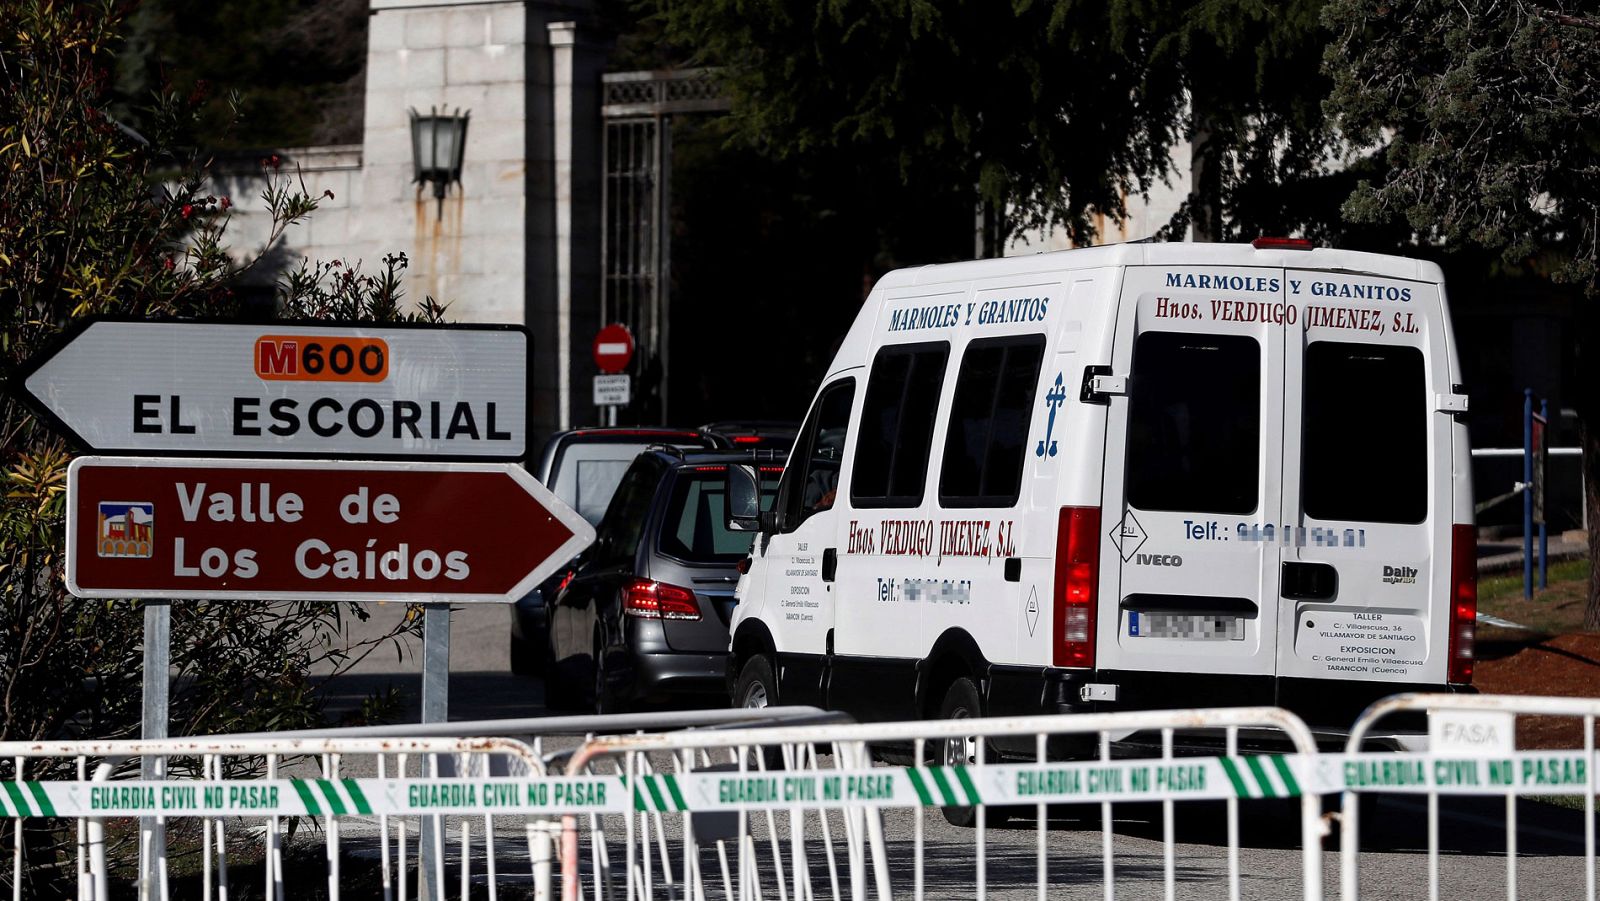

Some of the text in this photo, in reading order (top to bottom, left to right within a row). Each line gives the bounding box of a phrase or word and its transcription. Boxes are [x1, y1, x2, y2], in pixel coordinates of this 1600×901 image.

[1166, 273, 1412, 302] MARMOLES Y GRANITOS
[888, 297, 1049, 331] MARMOLES Y GRANITOS
[1155, 297, 1420, 336] Hnos. VERDUGO JIMENEZ, S.L.
[259, 340, 384, 376] M600
[133, 395, 512, 441] EL ESCORIAL
[175, 482, 400, 525] Valle de
[847, 519, 1016, 567] Hnos. VERDUGO JIMENEZ, S.L.
[1183, 520, 1229, 541] Telf.:
[173, 537, 470, 581] Los Caídos
[1136, 553, 1182, 567] IVECO
[1383, 565, 1418, 577] Daily
[877, 578, 900, 602] Telf.:
[1353, 613, 1382, 621] TALLER
[1340, 646, 1396, 655] EXPOSICION
[1441, 723, 1499, 742] FASA
[1017, 765, 1206, 795] GUARDIA CIVIL NO PASAR
[1344, 759, 1586, 786] GUARDIA CIVIL NO PASAR
[91, 786, 279, 809] GUARDIA CIVIL NO PASAR
[409, 783, 606, 807] GUARDIA CIVIL NO PASAR
[719, 776, 893, 802] GUARDIA CIVIL NO PASAR
